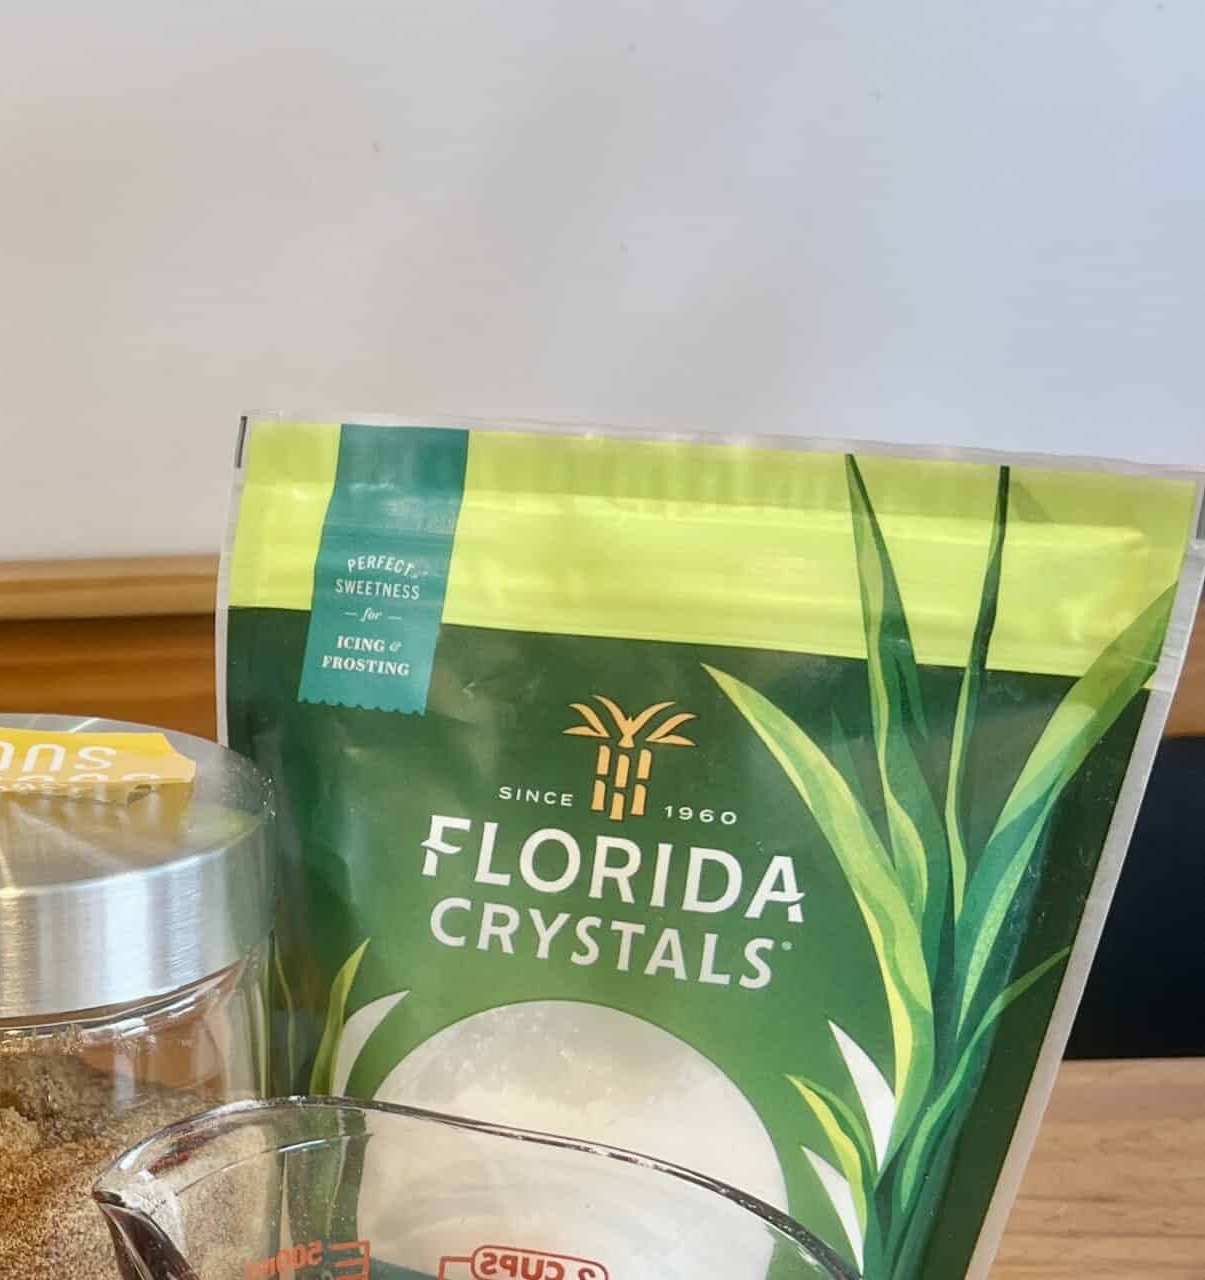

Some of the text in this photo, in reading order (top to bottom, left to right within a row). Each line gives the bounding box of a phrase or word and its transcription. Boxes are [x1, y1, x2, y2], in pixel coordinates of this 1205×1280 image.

[347, 555, 414, 577] PERFECT
[335, 578, 420, 600] SWEETNESS
[361, 608, 381, 622] for
[337, 635, 386, 652] ICING
[321, 655, 410, 676] FROSTING
[499, 786, 738, 825] SINCE 1960
[420, 815, 804, 923] FLORIDA
[429, 897, 775, 989] CRYSTALS
